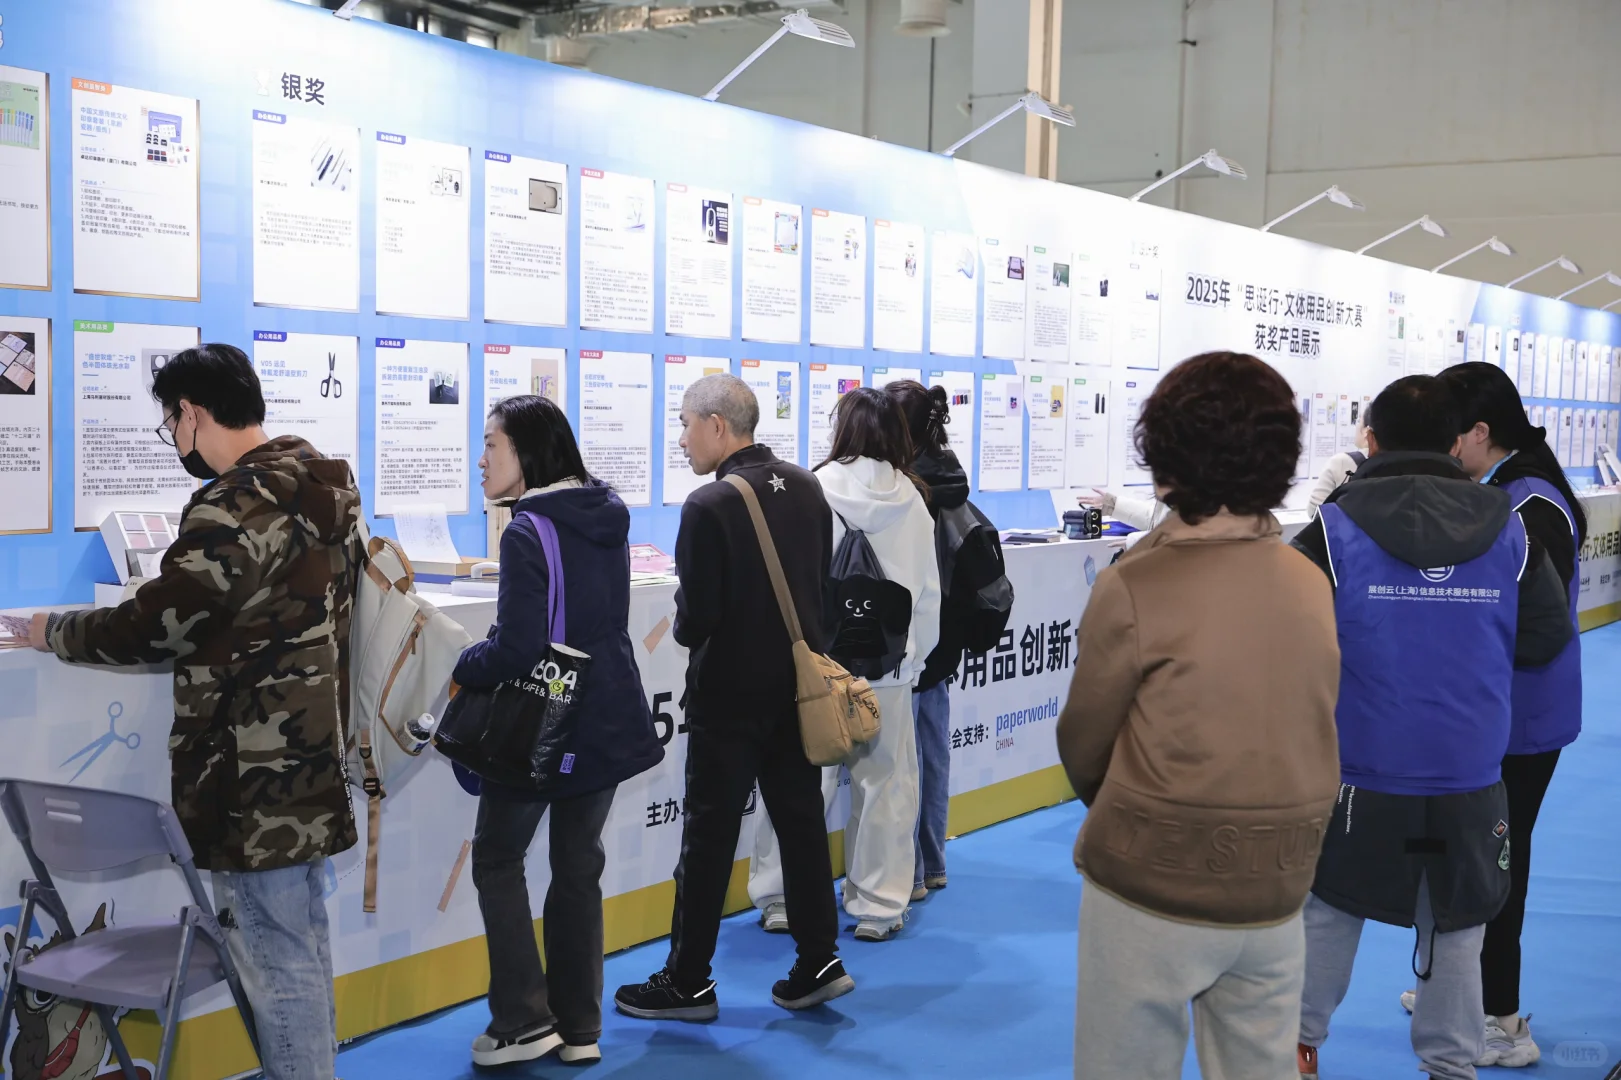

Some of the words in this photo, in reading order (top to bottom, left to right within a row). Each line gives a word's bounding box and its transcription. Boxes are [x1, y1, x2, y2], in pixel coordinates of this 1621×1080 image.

[281, 72, 325, 106] 银奖
[1255, 322, 1321, 356] 获奖产品展示
[945, 619, 1081, 694] 用品创新
[996, 696, 1059, 737] paperworld
[948, 722, 989, 750] 会支持：
[995, 737, 1015, 751] CHINA
[646, 797, 687, 828] 主办
